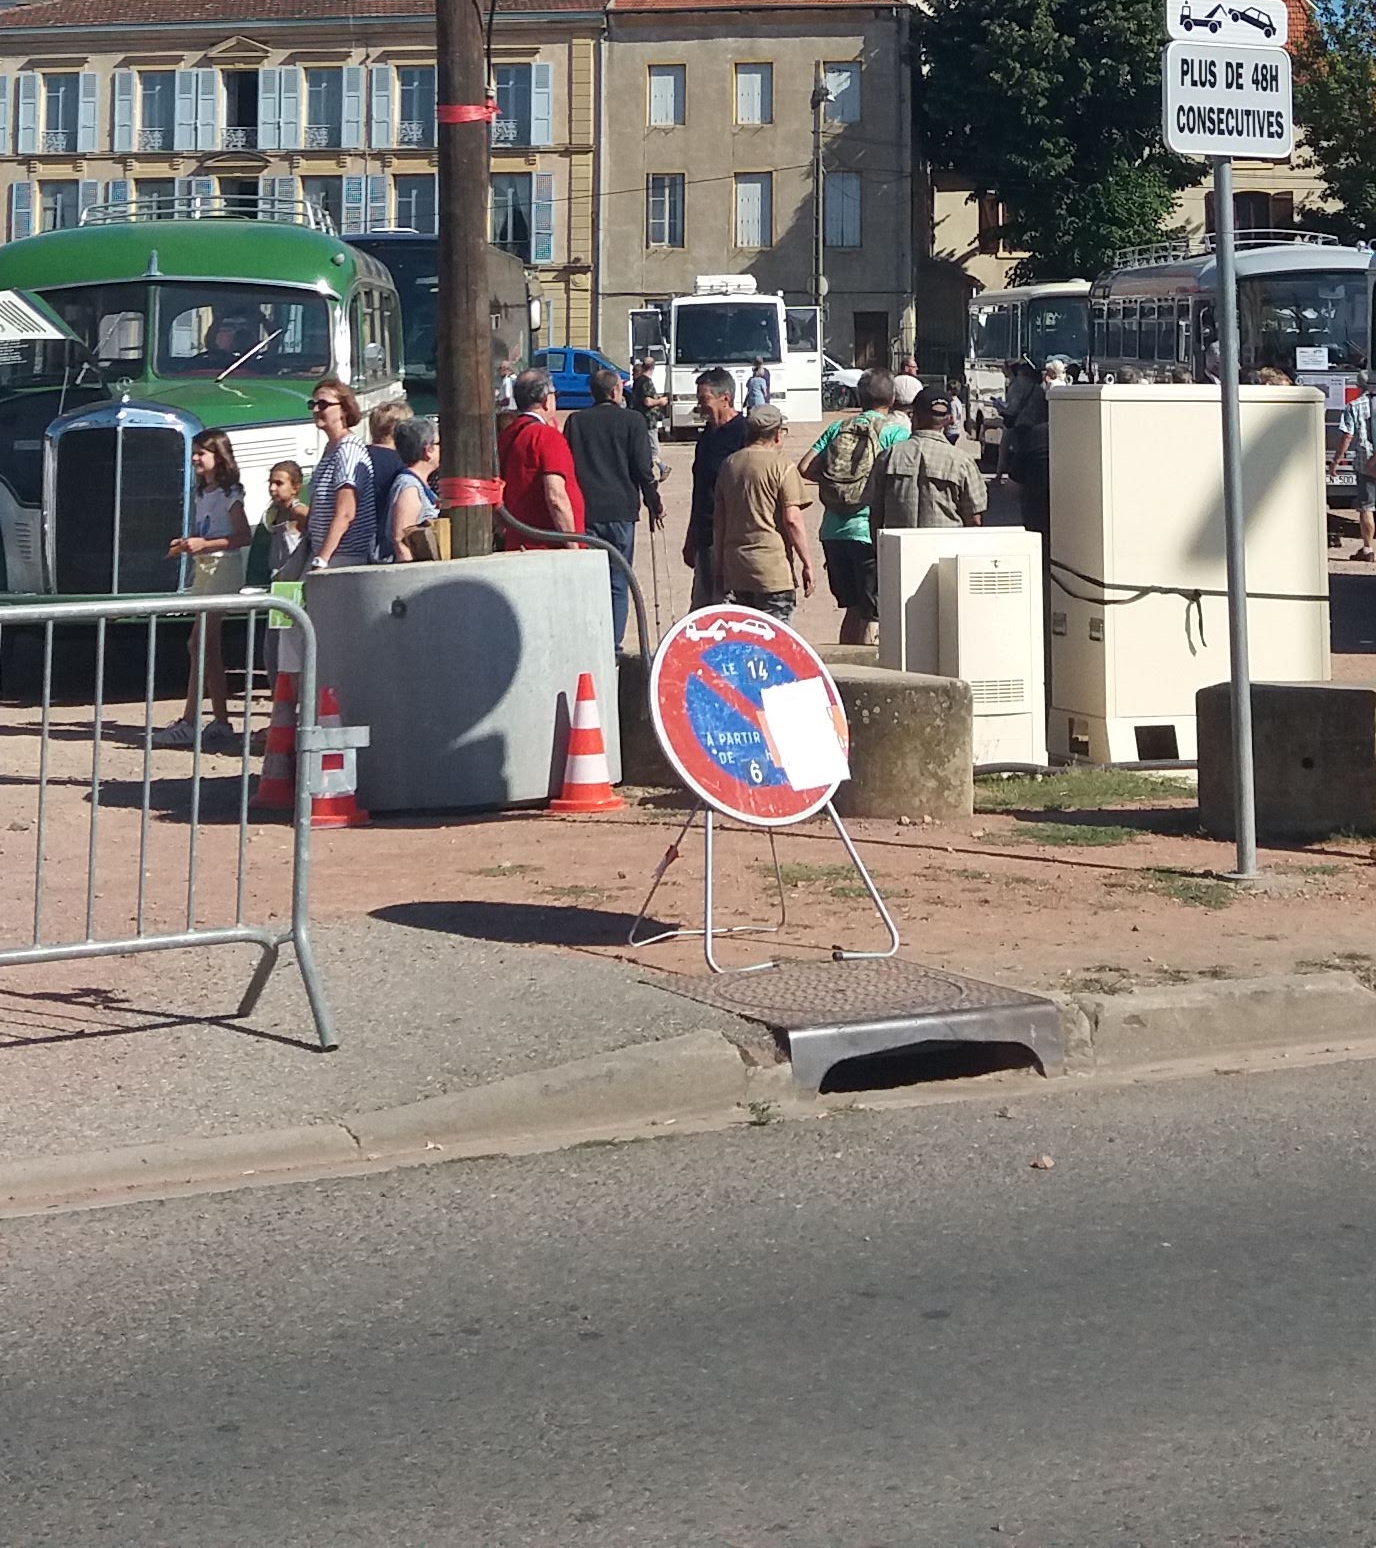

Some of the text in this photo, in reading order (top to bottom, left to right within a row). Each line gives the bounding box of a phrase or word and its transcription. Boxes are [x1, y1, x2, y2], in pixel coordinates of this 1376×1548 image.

[1180, 57, 1279, 93] PLUS DE 48H
[1176, 104, 1284, 139] CONSECUTIVES
[722, 660, 769, 681] LE 14
[718, 731, 761, 746] PARTIR
[718, 751, 735, 765] DE
[749, 763, 763, 784] 6
